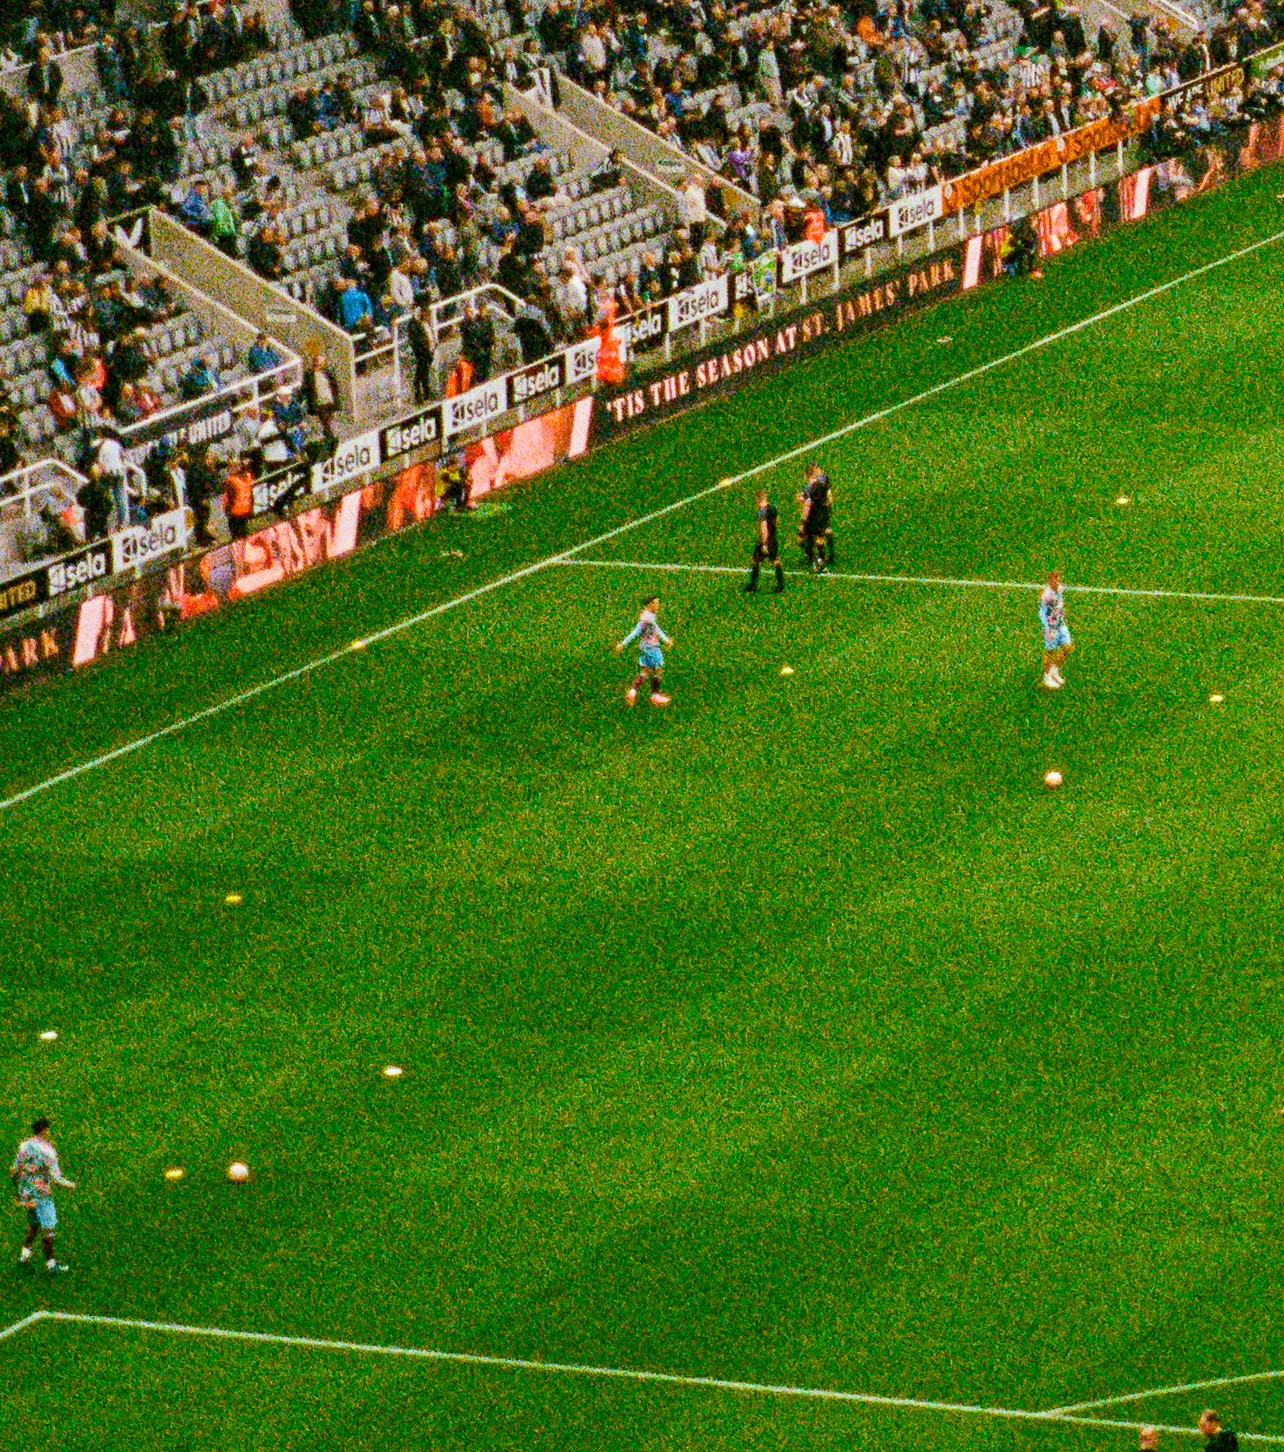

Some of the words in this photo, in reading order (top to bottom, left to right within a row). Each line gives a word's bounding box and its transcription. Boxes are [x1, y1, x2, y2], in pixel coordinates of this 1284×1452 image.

[691, 288, 719, 318] sela
[606, 389, 645, 422] 'TIS
[649, 371, 689, 407] THE
[696, 337, 769, 388] SEASON
[775, 324, 797, 355] AT
[802, 311, 831, 343] ST.
[908, 259, 955, 297] PARK
[527, 364, 560, 395] sela
[466, 391, 498, 422] sela
[402, 417, 436, 451] sela
[336, 444, 371, 477] sela
[139, 523, 177, 557] sela
[65, 551, 106, 587] sela
